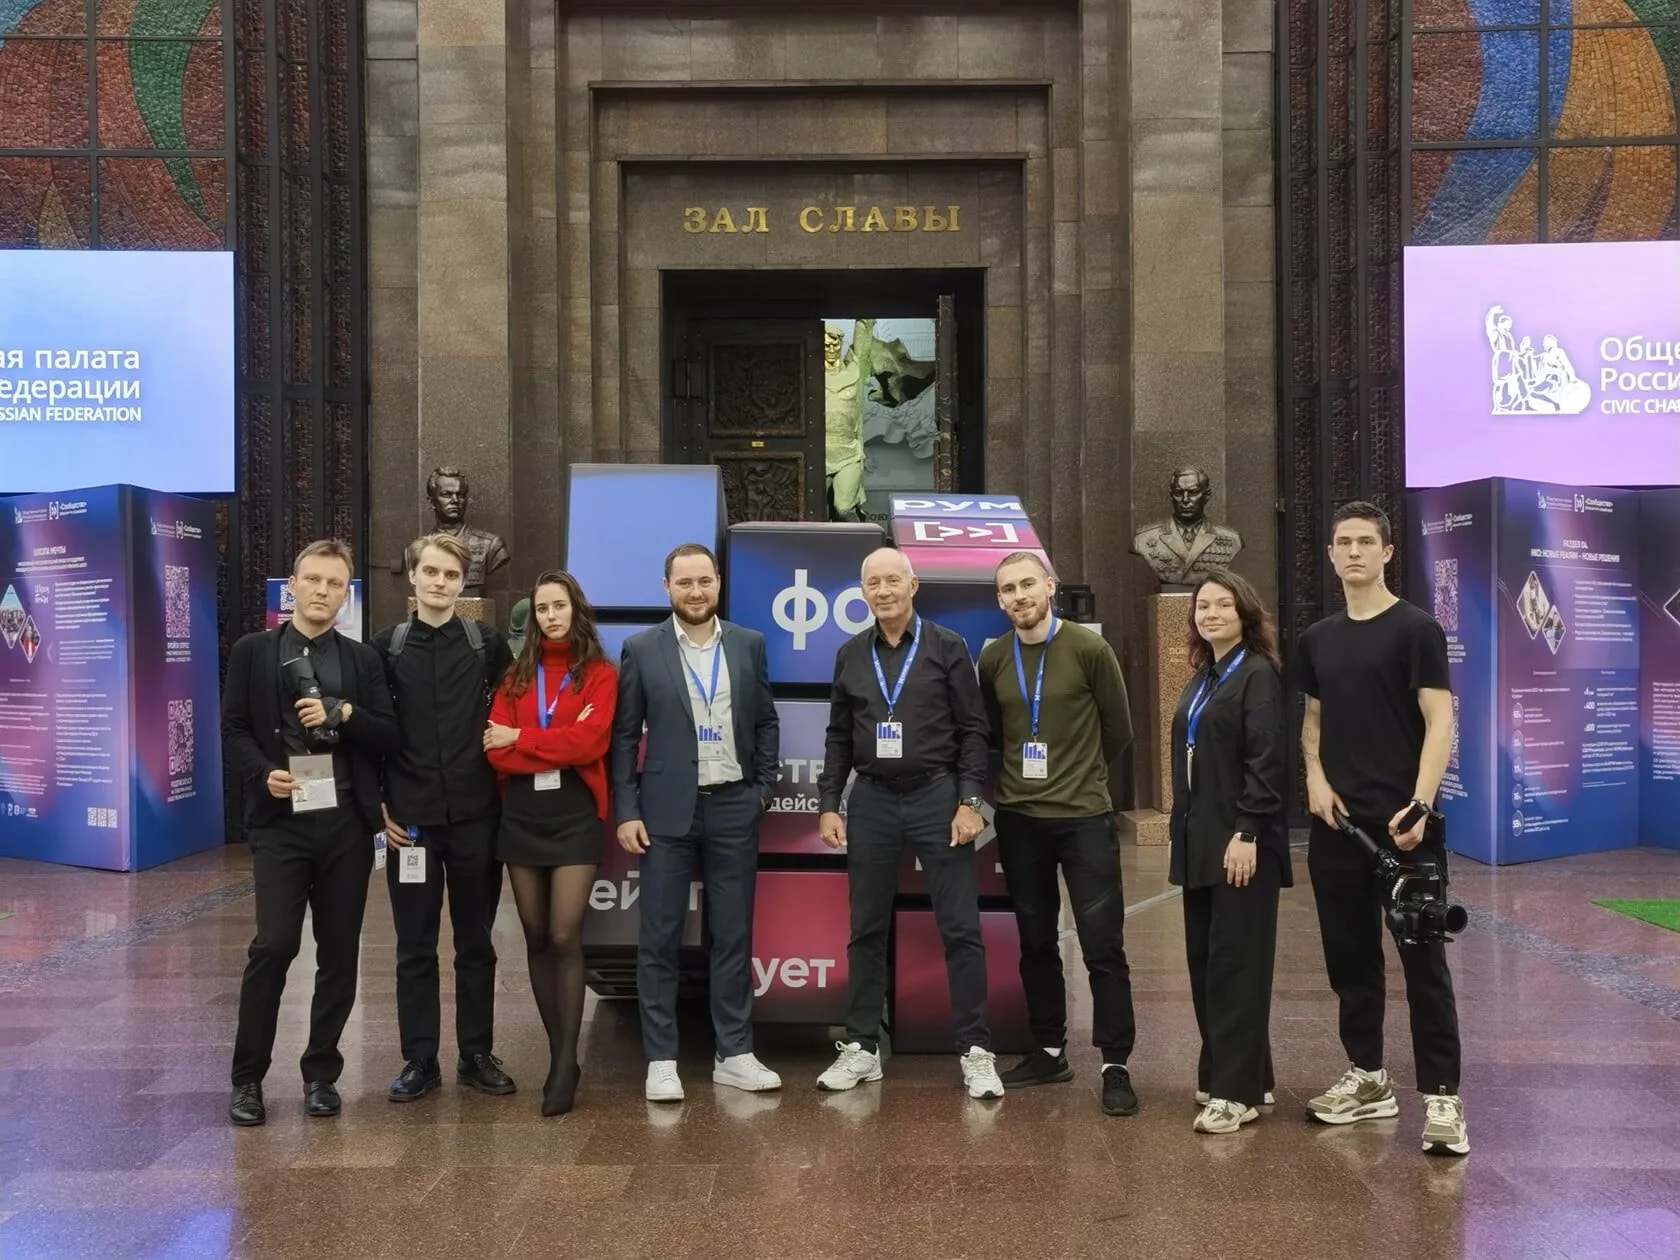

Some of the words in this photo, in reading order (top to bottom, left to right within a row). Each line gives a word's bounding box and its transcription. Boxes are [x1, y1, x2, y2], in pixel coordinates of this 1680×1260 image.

[682, 207, 770, 233] ЗАЛ
[800, 206, 961, 233] СЛАВЫ
[35, 350, 140, 369] палата
[46, 407, 141, 421] FEDERATION
[1601, 399, 1641, 414] CIVIC
[893, 500, 1022, 511] рум
[772, 568, 877, 650] фо
